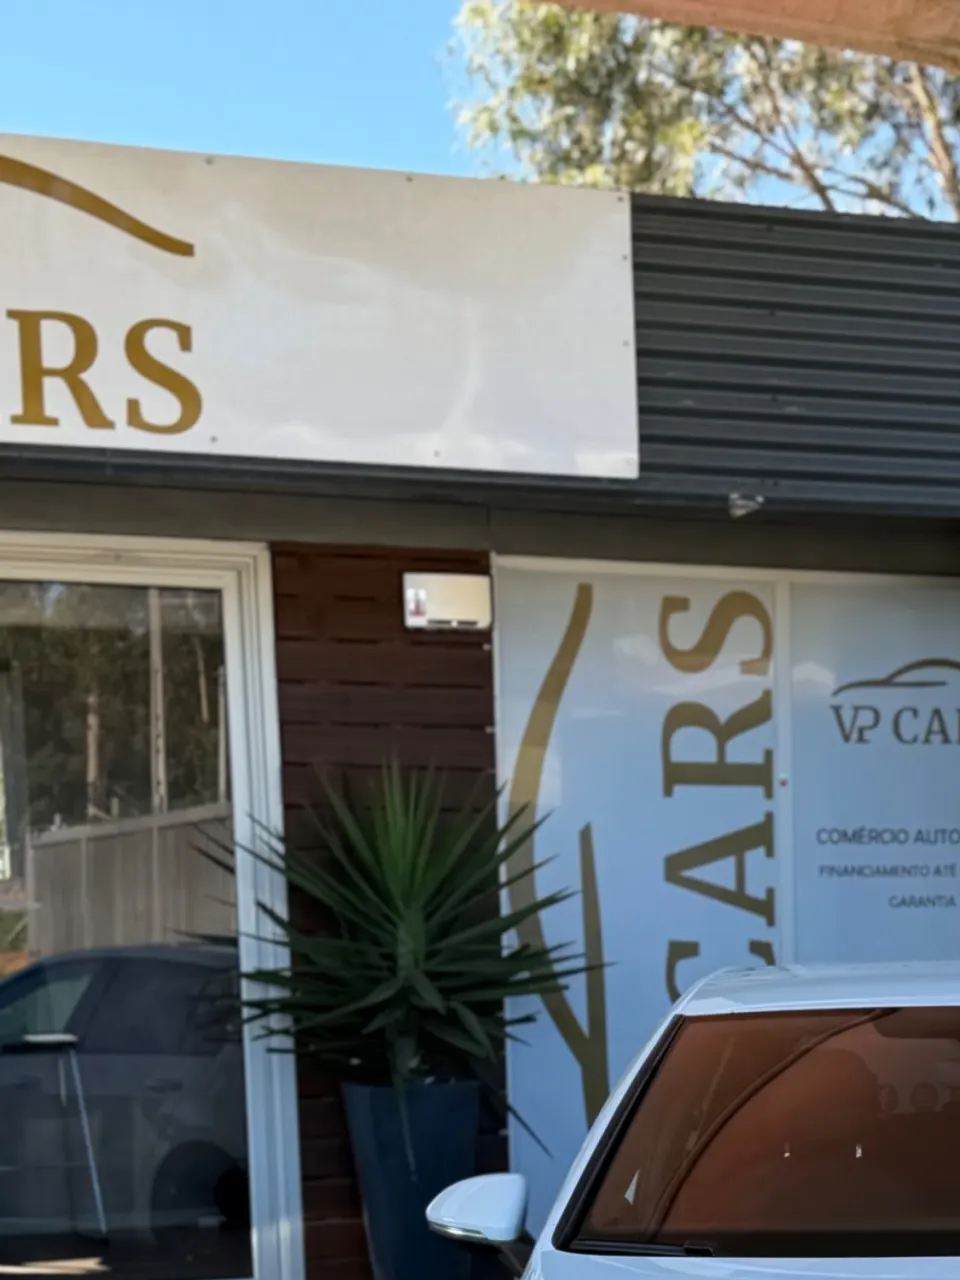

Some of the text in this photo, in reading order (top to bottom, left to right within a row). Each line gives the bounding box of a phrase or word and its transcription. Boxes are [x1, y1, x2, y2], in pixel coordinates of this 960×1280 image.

[831, 704, 881, 744] VP
[816, 825, 909, 845] COMÉRCIO
[817, 863, 930, 878] FINANCIAMENTO
[887, 894, 957, 909] GARANTIA
